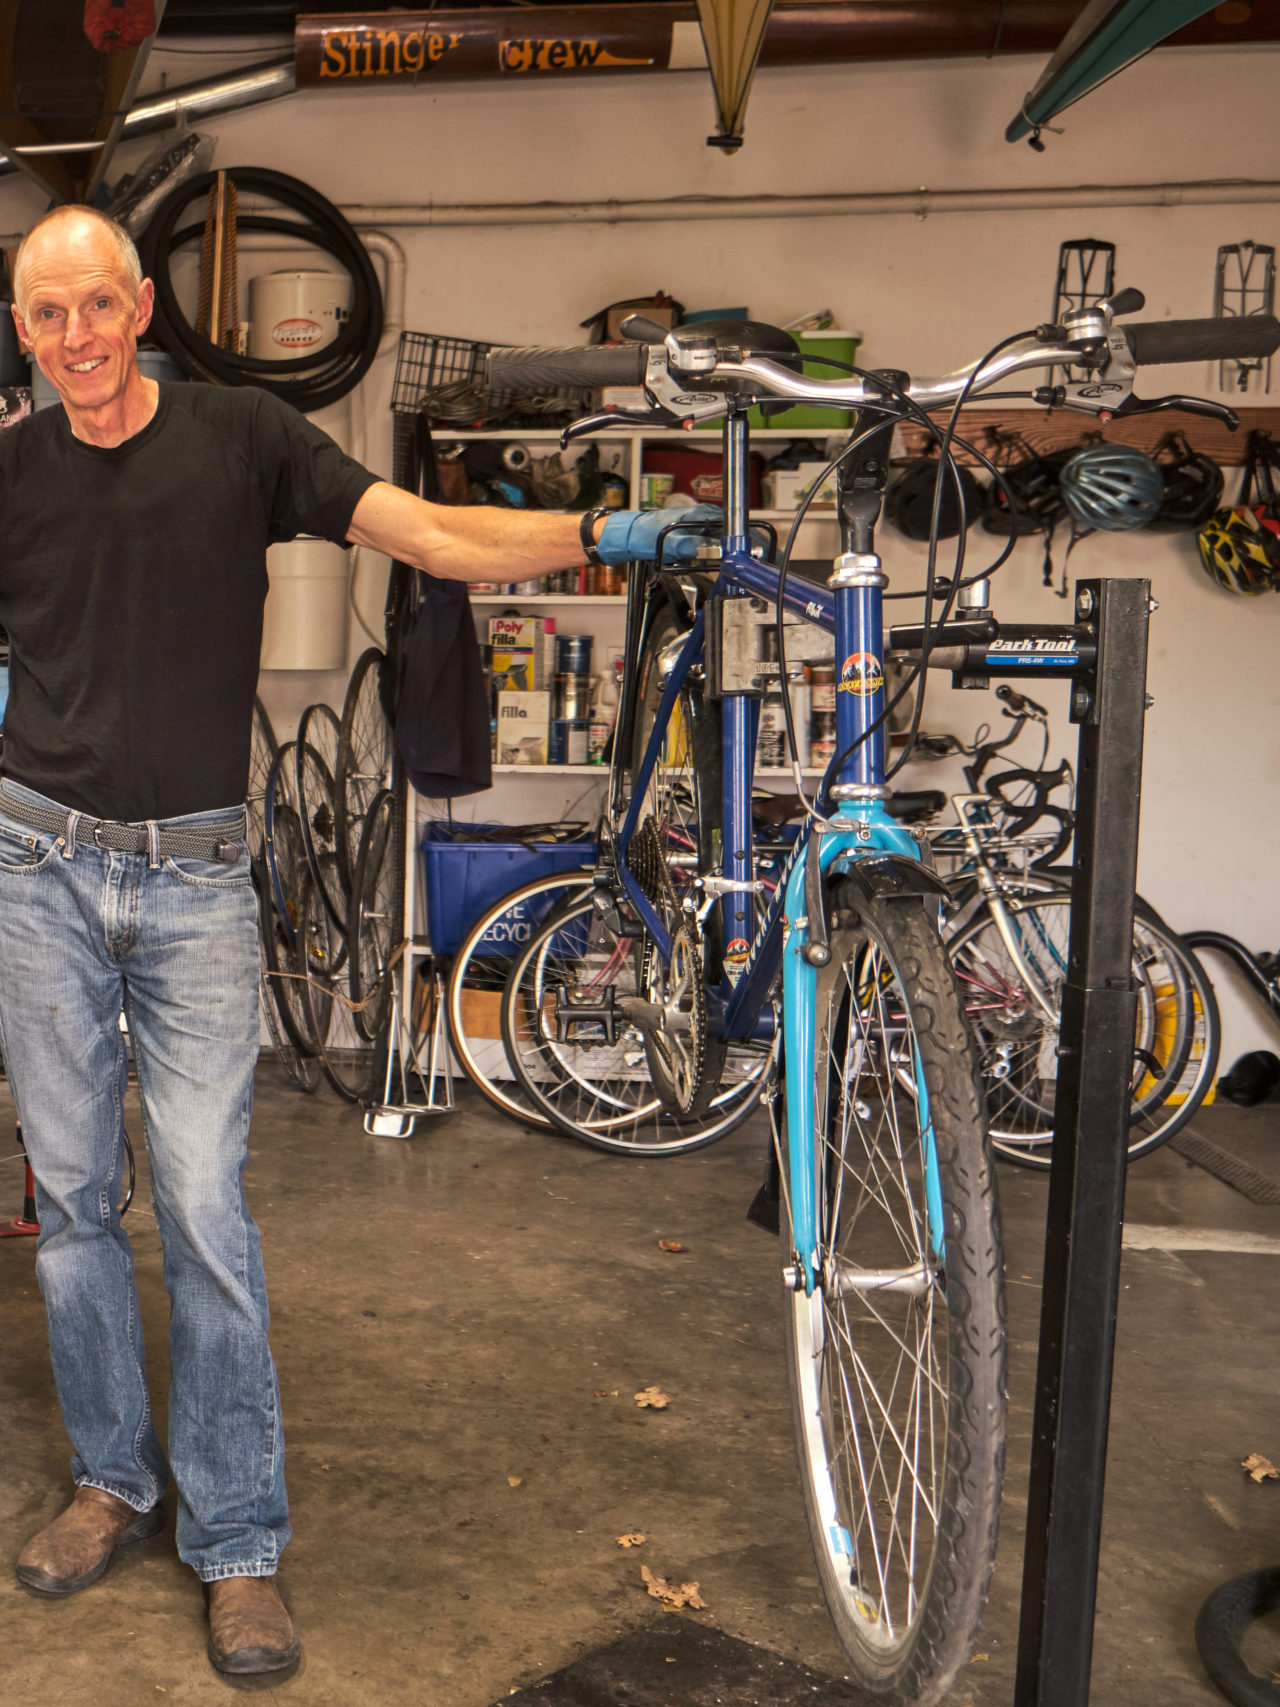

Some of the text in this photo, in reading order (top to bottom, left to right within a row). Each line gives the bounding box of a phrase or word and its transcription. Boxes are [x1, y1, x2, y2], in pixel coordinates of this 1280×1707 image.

[320, 31, 463, 78] Stinger
[496, 620, 523, 634] Poly
[491, 633, 516, 645] filla
[988, 639, 1076, 651] Park Tool
